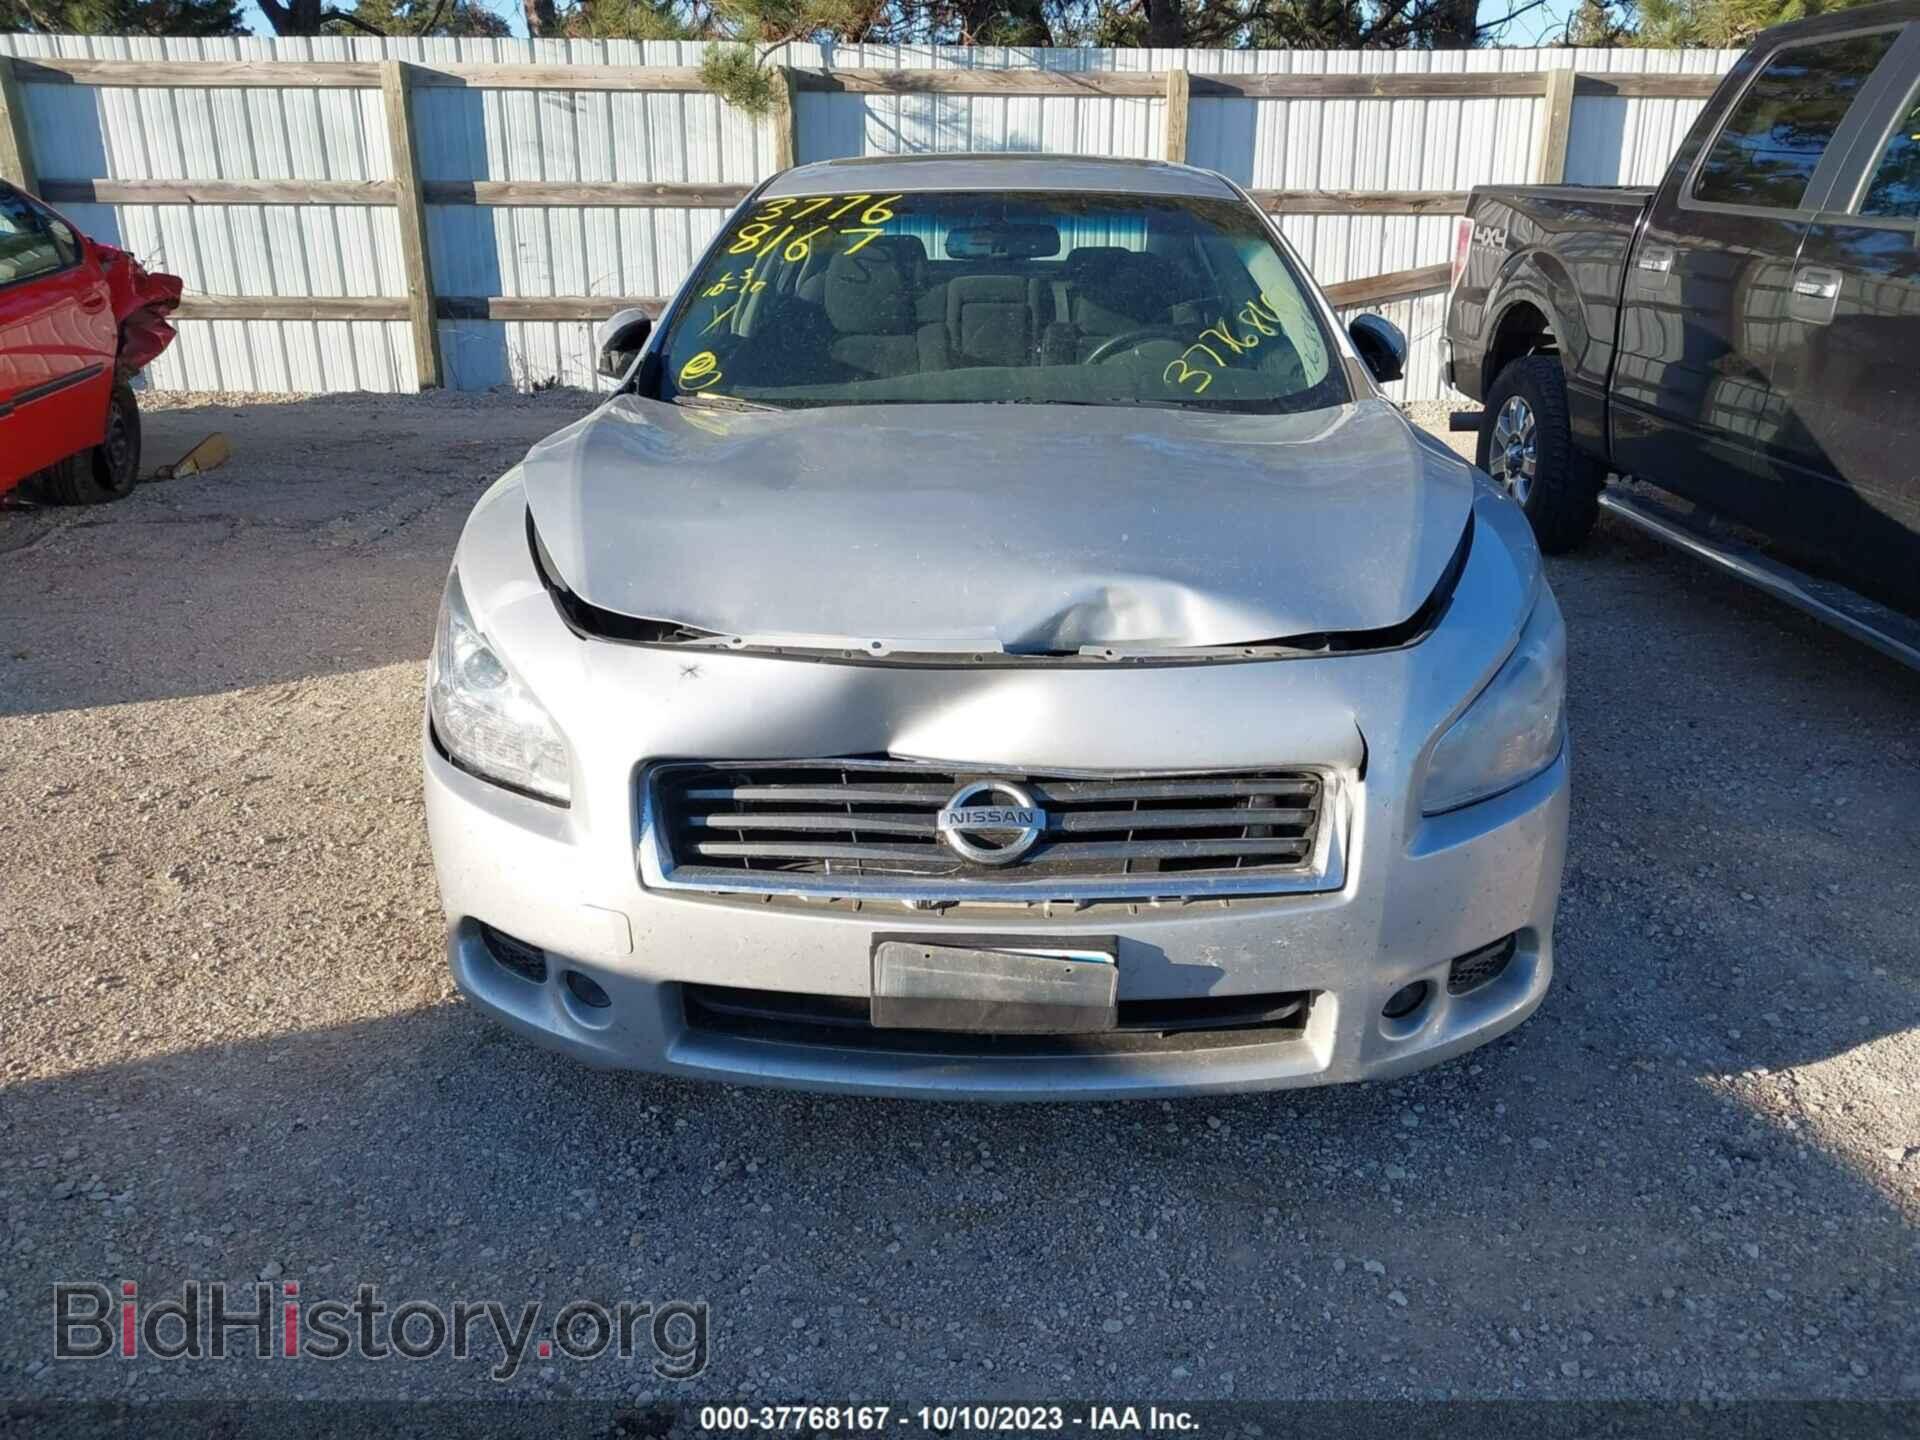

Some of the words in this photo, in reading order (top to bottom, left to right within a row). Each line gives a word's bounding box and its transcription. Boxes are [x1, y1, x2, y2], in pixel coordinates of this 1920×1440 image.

[755, 194, 903, 224] 3776
[728, 223, 886, 262] 8167
[949, 811, 1033, 824] NISSAN
